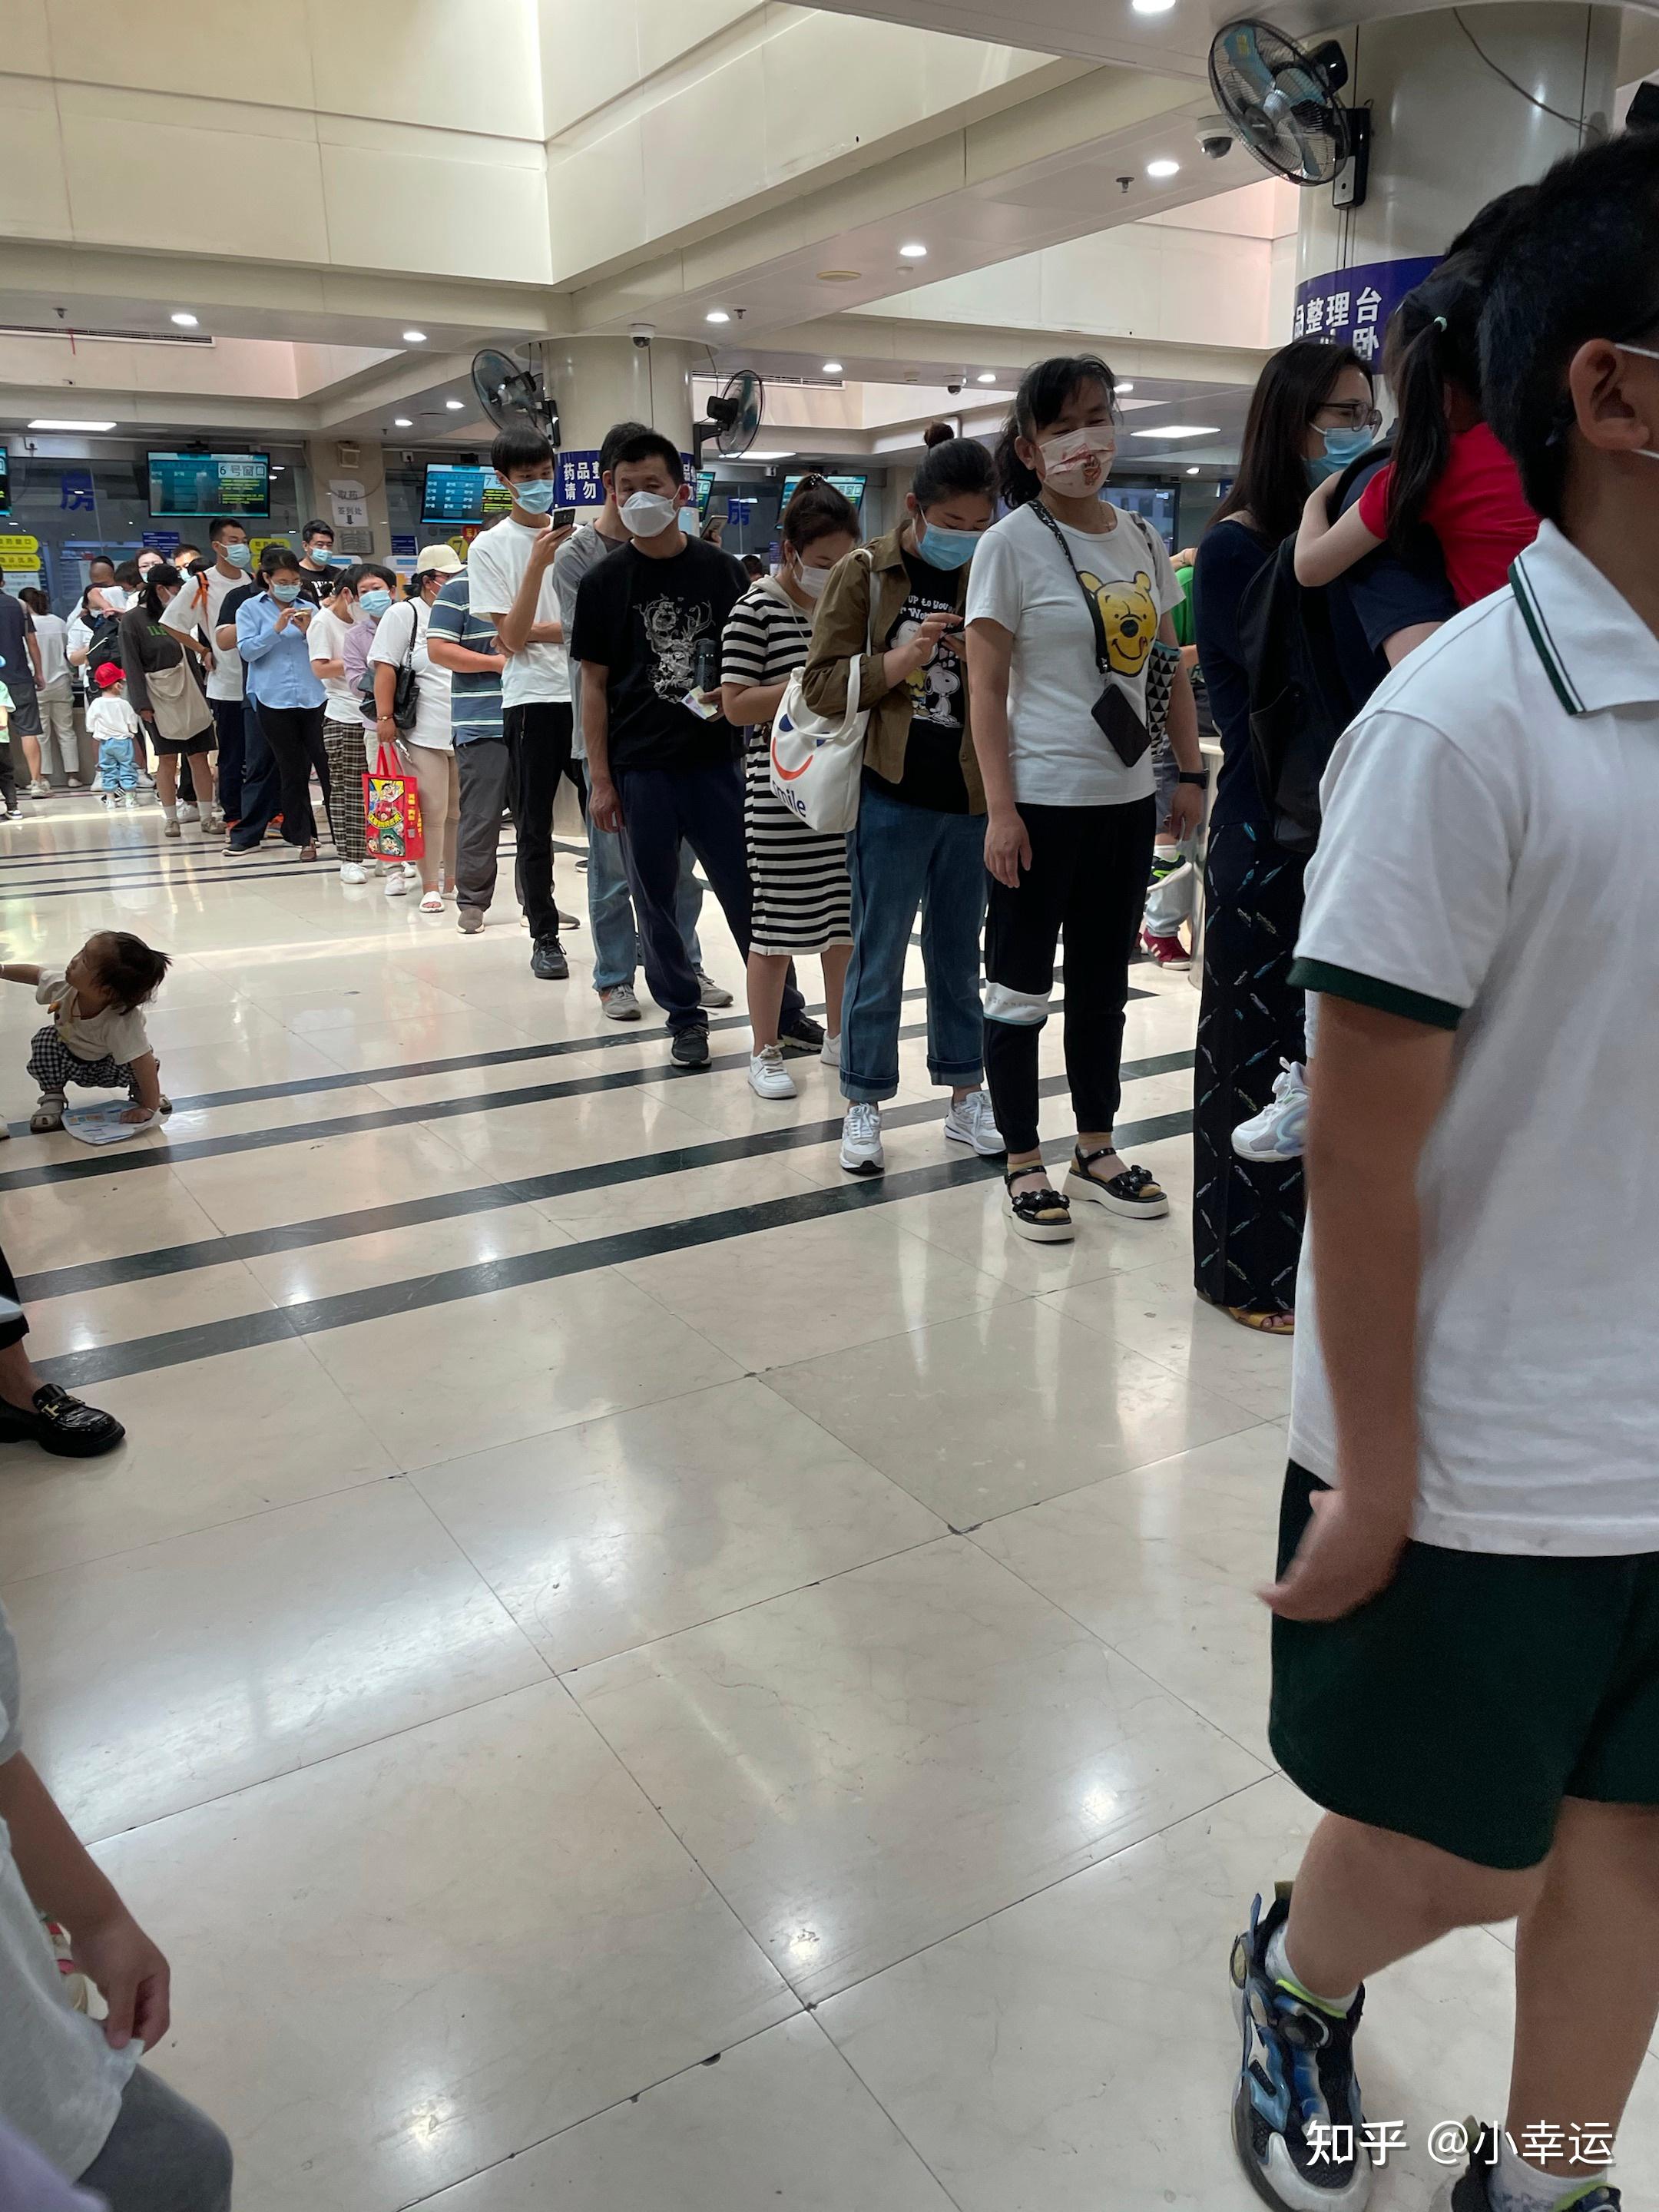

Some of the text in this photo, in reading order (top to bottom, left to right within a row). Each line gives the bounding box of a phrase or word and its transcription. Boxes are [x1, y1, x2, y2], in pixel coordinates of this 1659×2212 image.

[61, 469, 94, 512] 房
[565, 481, 597, 501] 请勿
[338, 506, 363, 515] 签到处
[727, 495, 751, 526] 房
